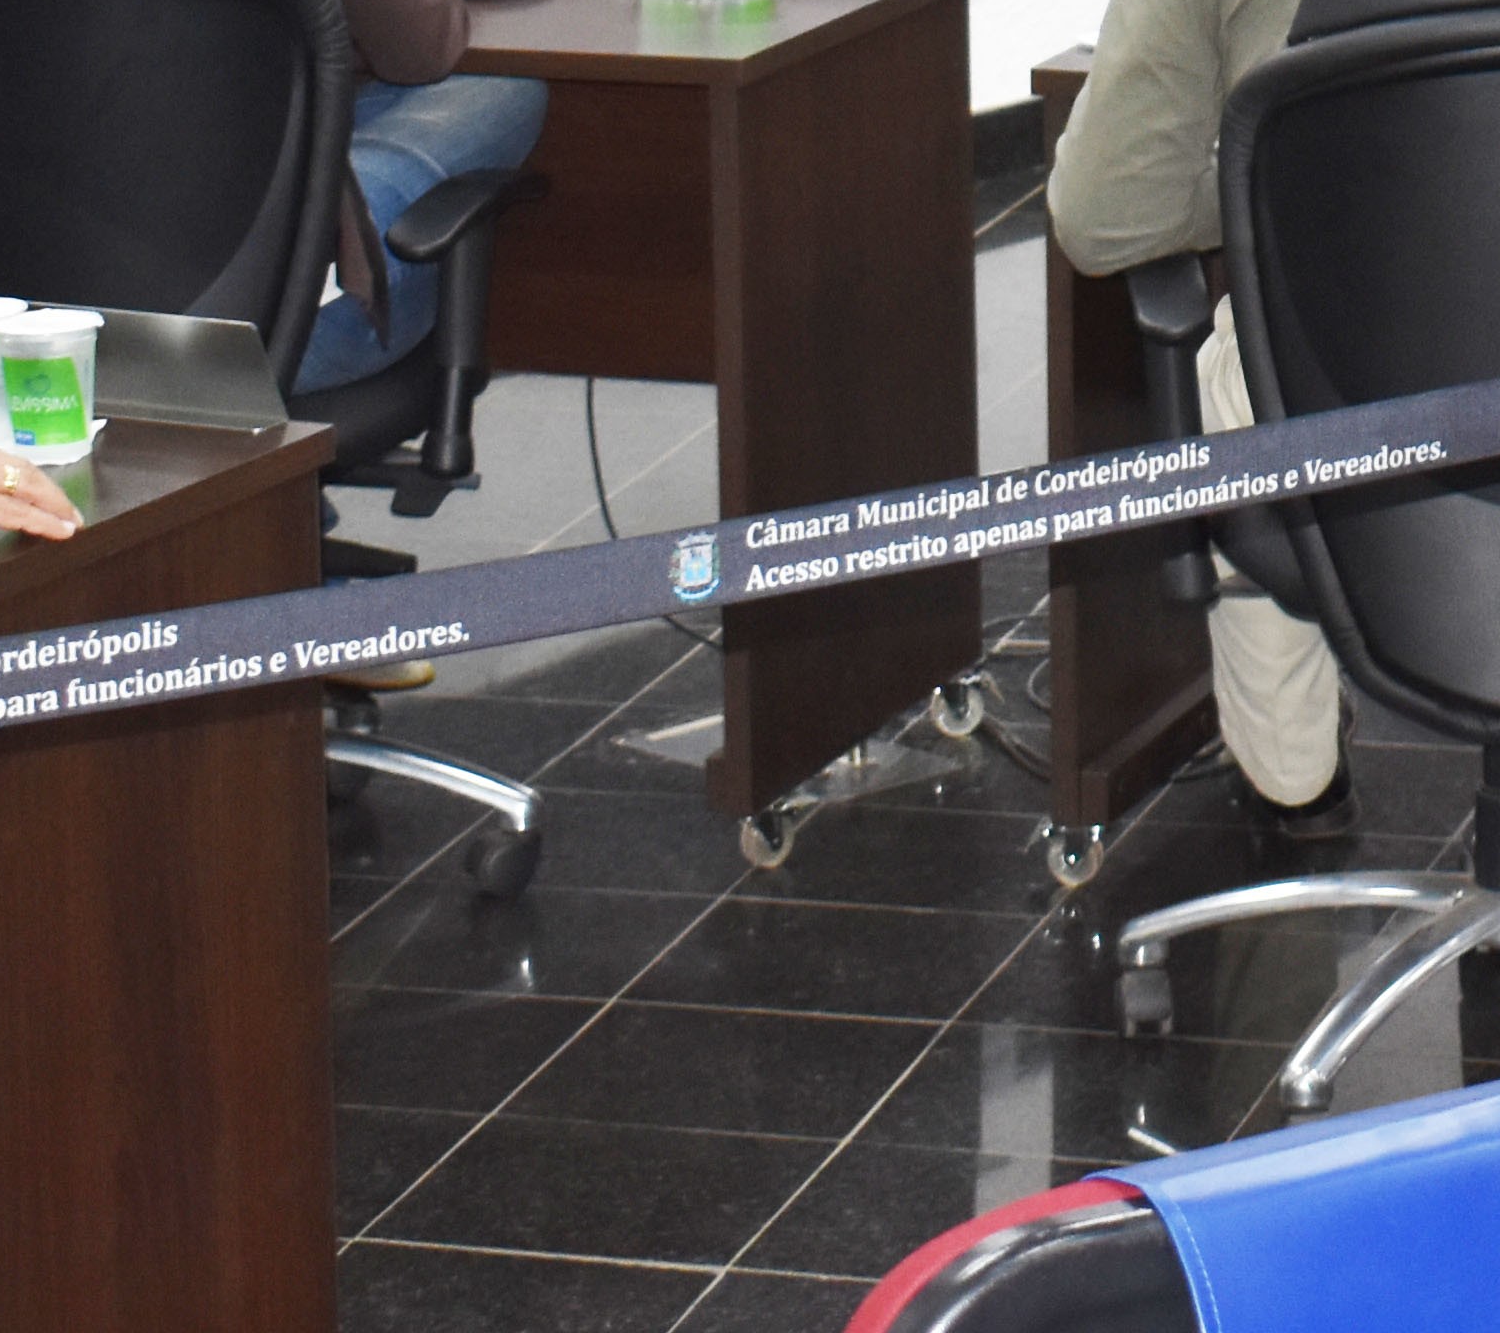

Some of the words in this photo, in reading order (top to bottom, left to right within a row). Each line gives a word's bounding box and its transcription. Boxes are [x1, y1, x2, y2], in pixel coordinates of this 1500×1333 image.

[746, 511, 850, 549] Câmara
[857, 480, 990, 529] Municipal
[996, 475, 1028, 504] de
[1035, 442, 1211, 496] Cordeirópolis
[746, 553, 839, 592] Acesso
[846, 533, 947, 573] restrito
[953, 516, 1047, 558] apenas
[1053, 503, 1113, 542] para
[1119, 472, 1278, 522] funcionários
[1284, 468, 1299, 489] e
[1304, 440, 1448, 484] Vereadores.
[66, 654, 263, 709] funcionários
[269, 651, 288, 674] e
[294, 621, 470, 669] Vereadores.
